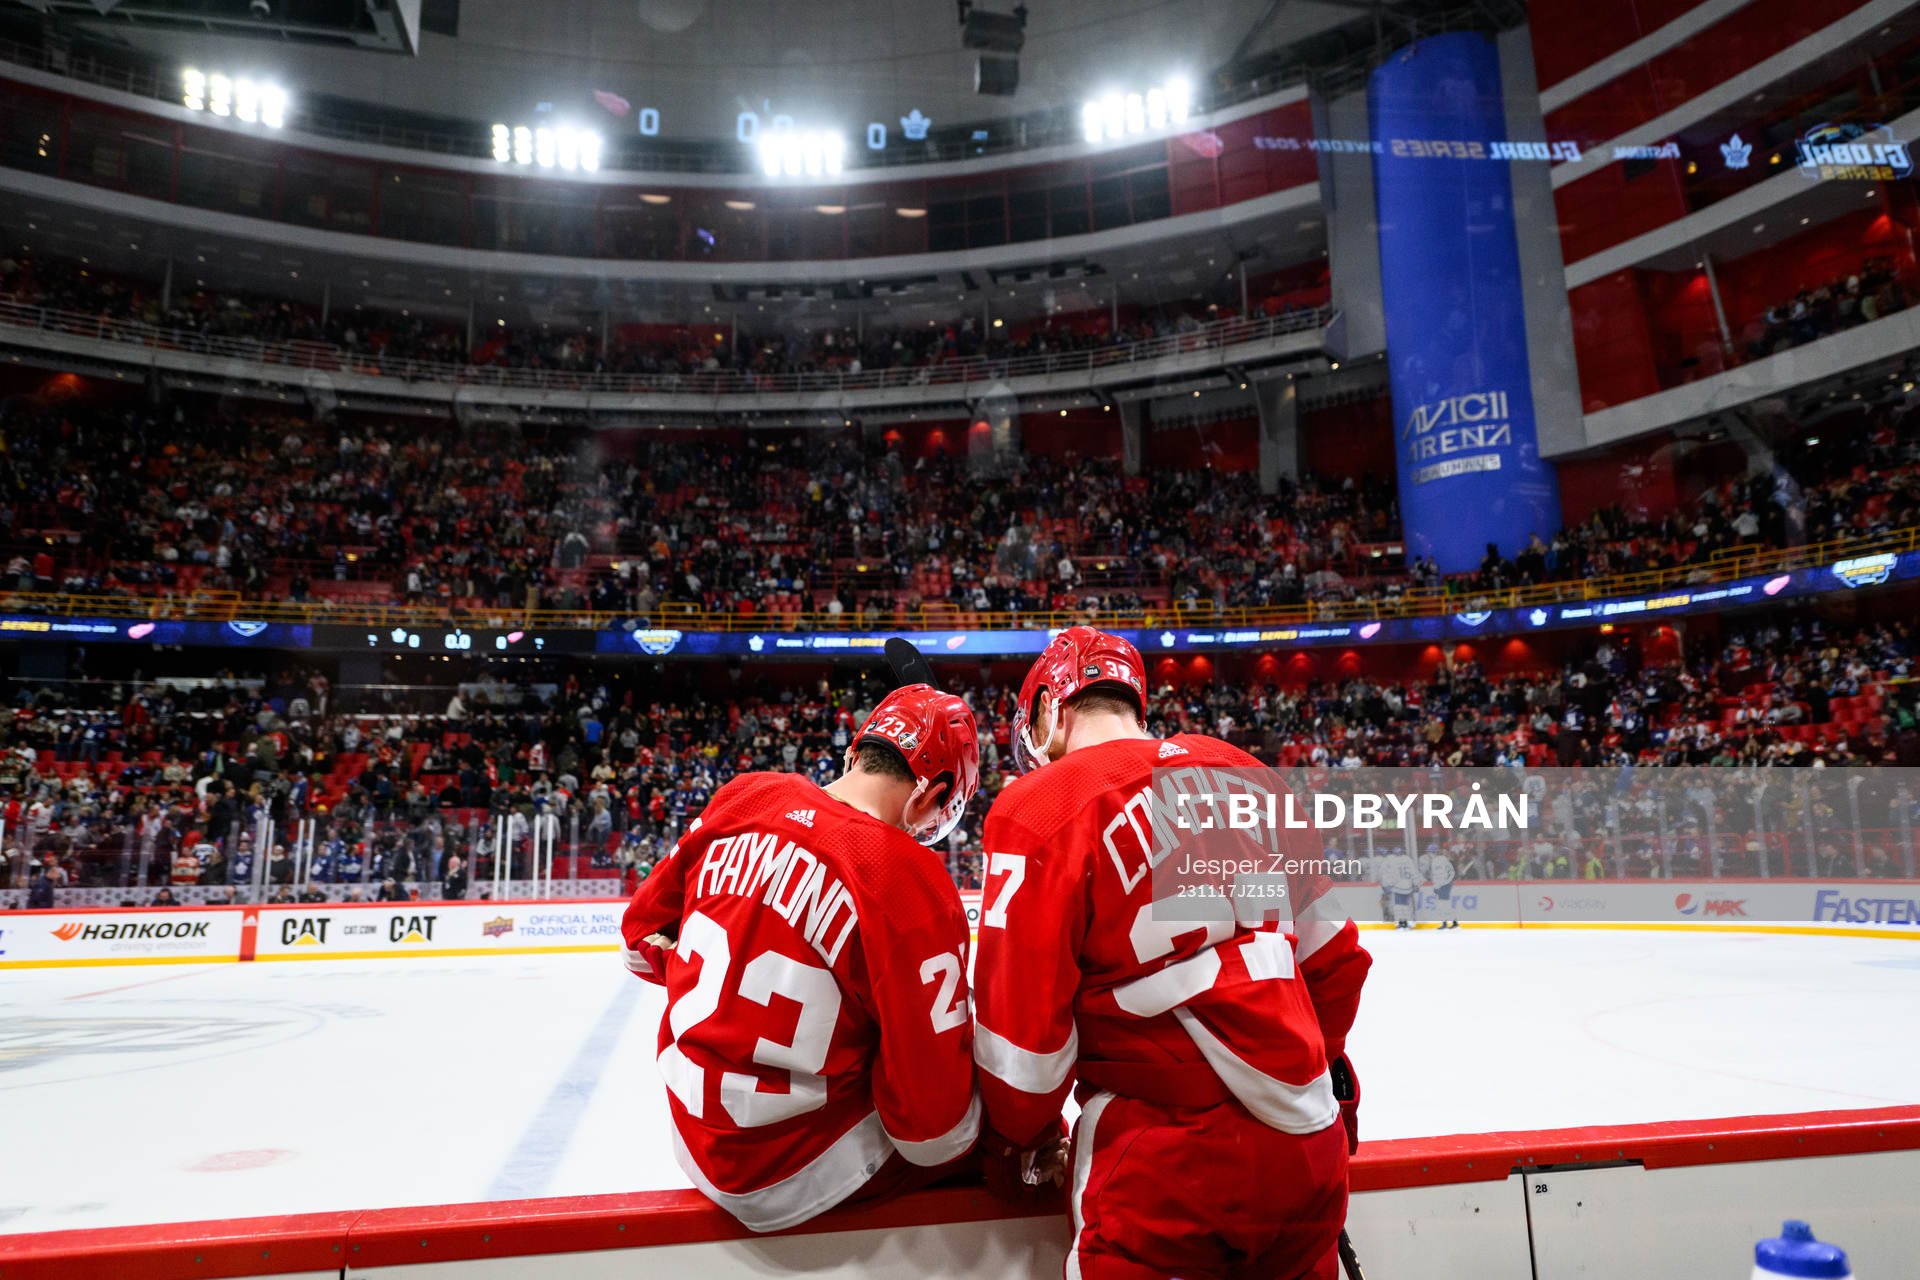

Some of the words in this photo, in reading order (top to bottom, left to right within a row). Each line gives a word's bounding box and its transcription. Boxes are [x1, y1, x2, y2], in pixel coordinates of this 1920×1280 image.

[1402, 391, 1508, 442] AVICII
[1407, 423, 1511, 465] ARENA
[876, 716, 906, 738] 23
[1158, 748, 1190, 759] adidas
[785, 812, 815, 828] adidas
[696, 832, 859, 969] RAYMOND
[982, 851, 1027, 930] 7
[281, 916, 331, 946] CAT
[390, 915, 438, 943] CAT
[519, 925, 578, 937] TRADING
[529, 914, 588, 926] OFFICIAL
[592, 913, 615, 923] NHL
[918, 942, 973, 1035] 2
[656, 909, 843, 1129] 23
[1535, 1183, 1549, 1194] 28
